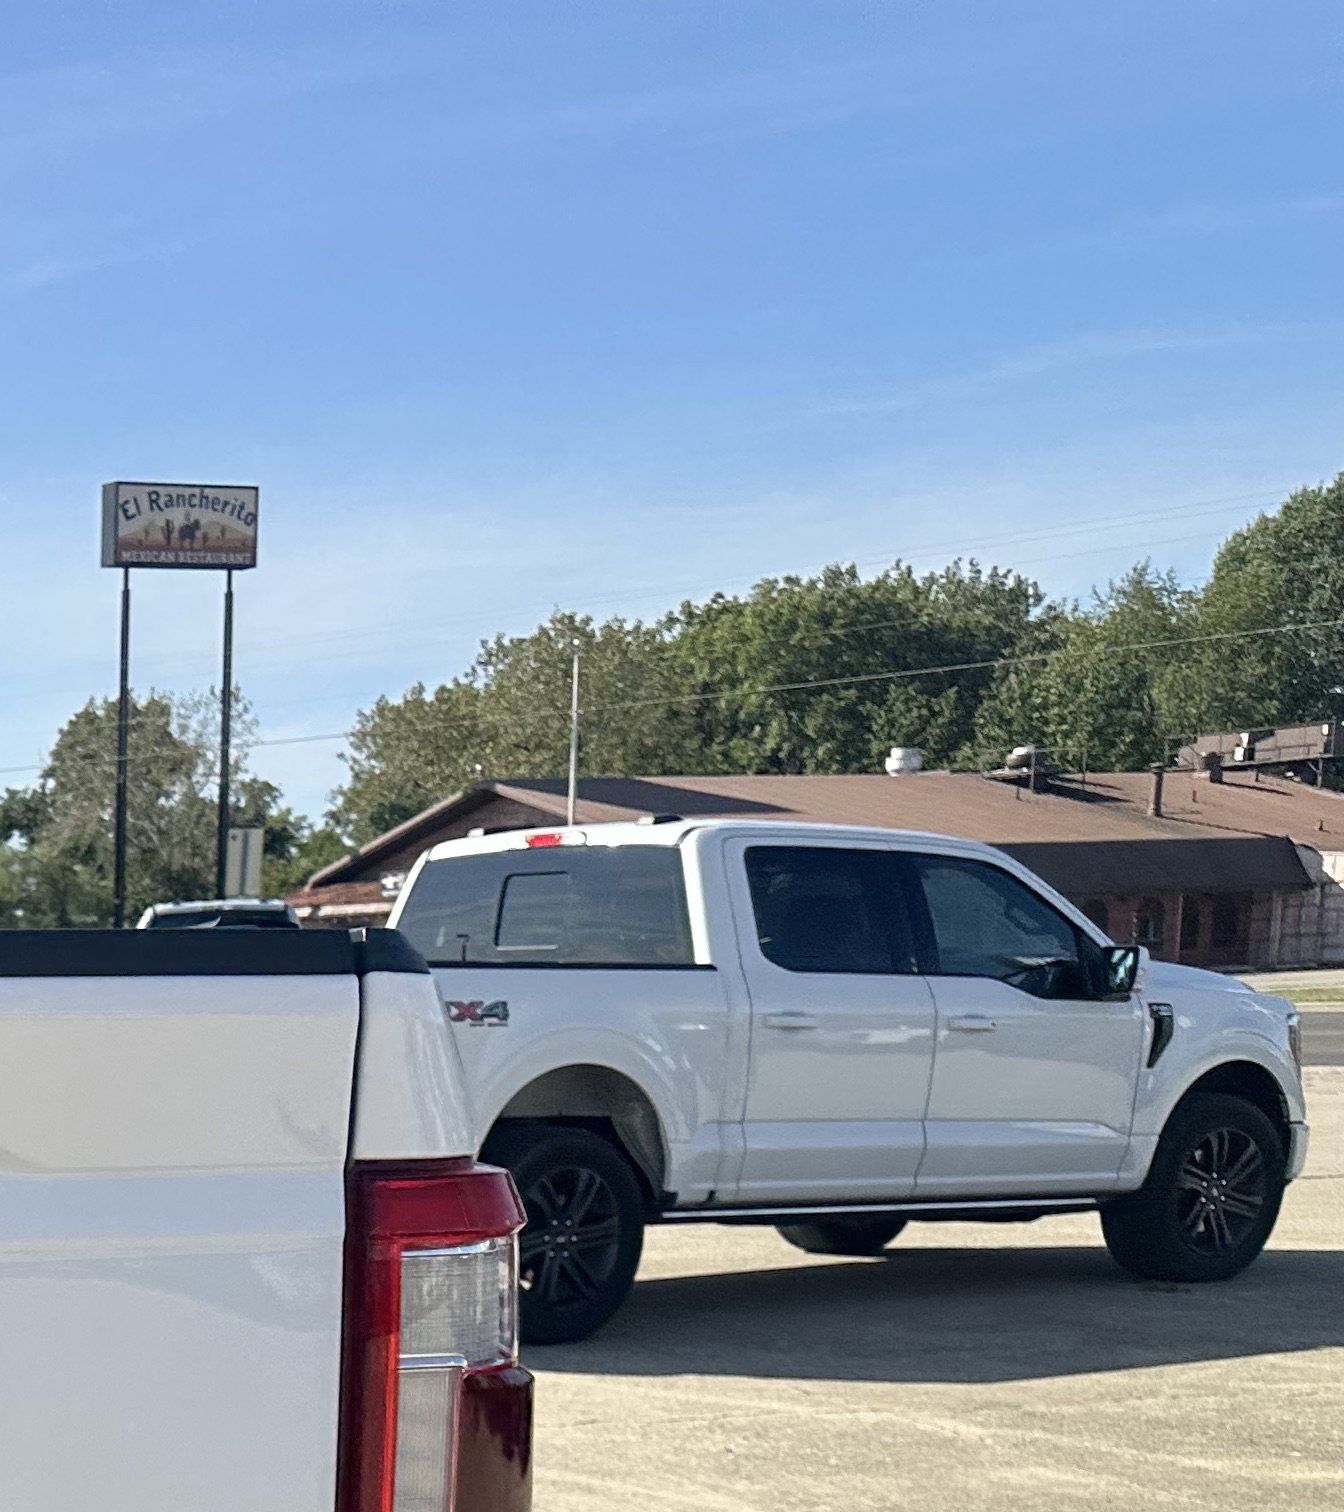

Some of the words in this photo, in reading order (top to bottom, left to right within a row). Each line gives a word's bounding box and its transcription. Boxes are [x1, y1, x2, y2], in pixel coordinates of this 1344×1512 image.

[119, 496, 142, 521] El
[147, 488, 257, 527] Rancherito
[445, 1000, 509, 1022] X4
